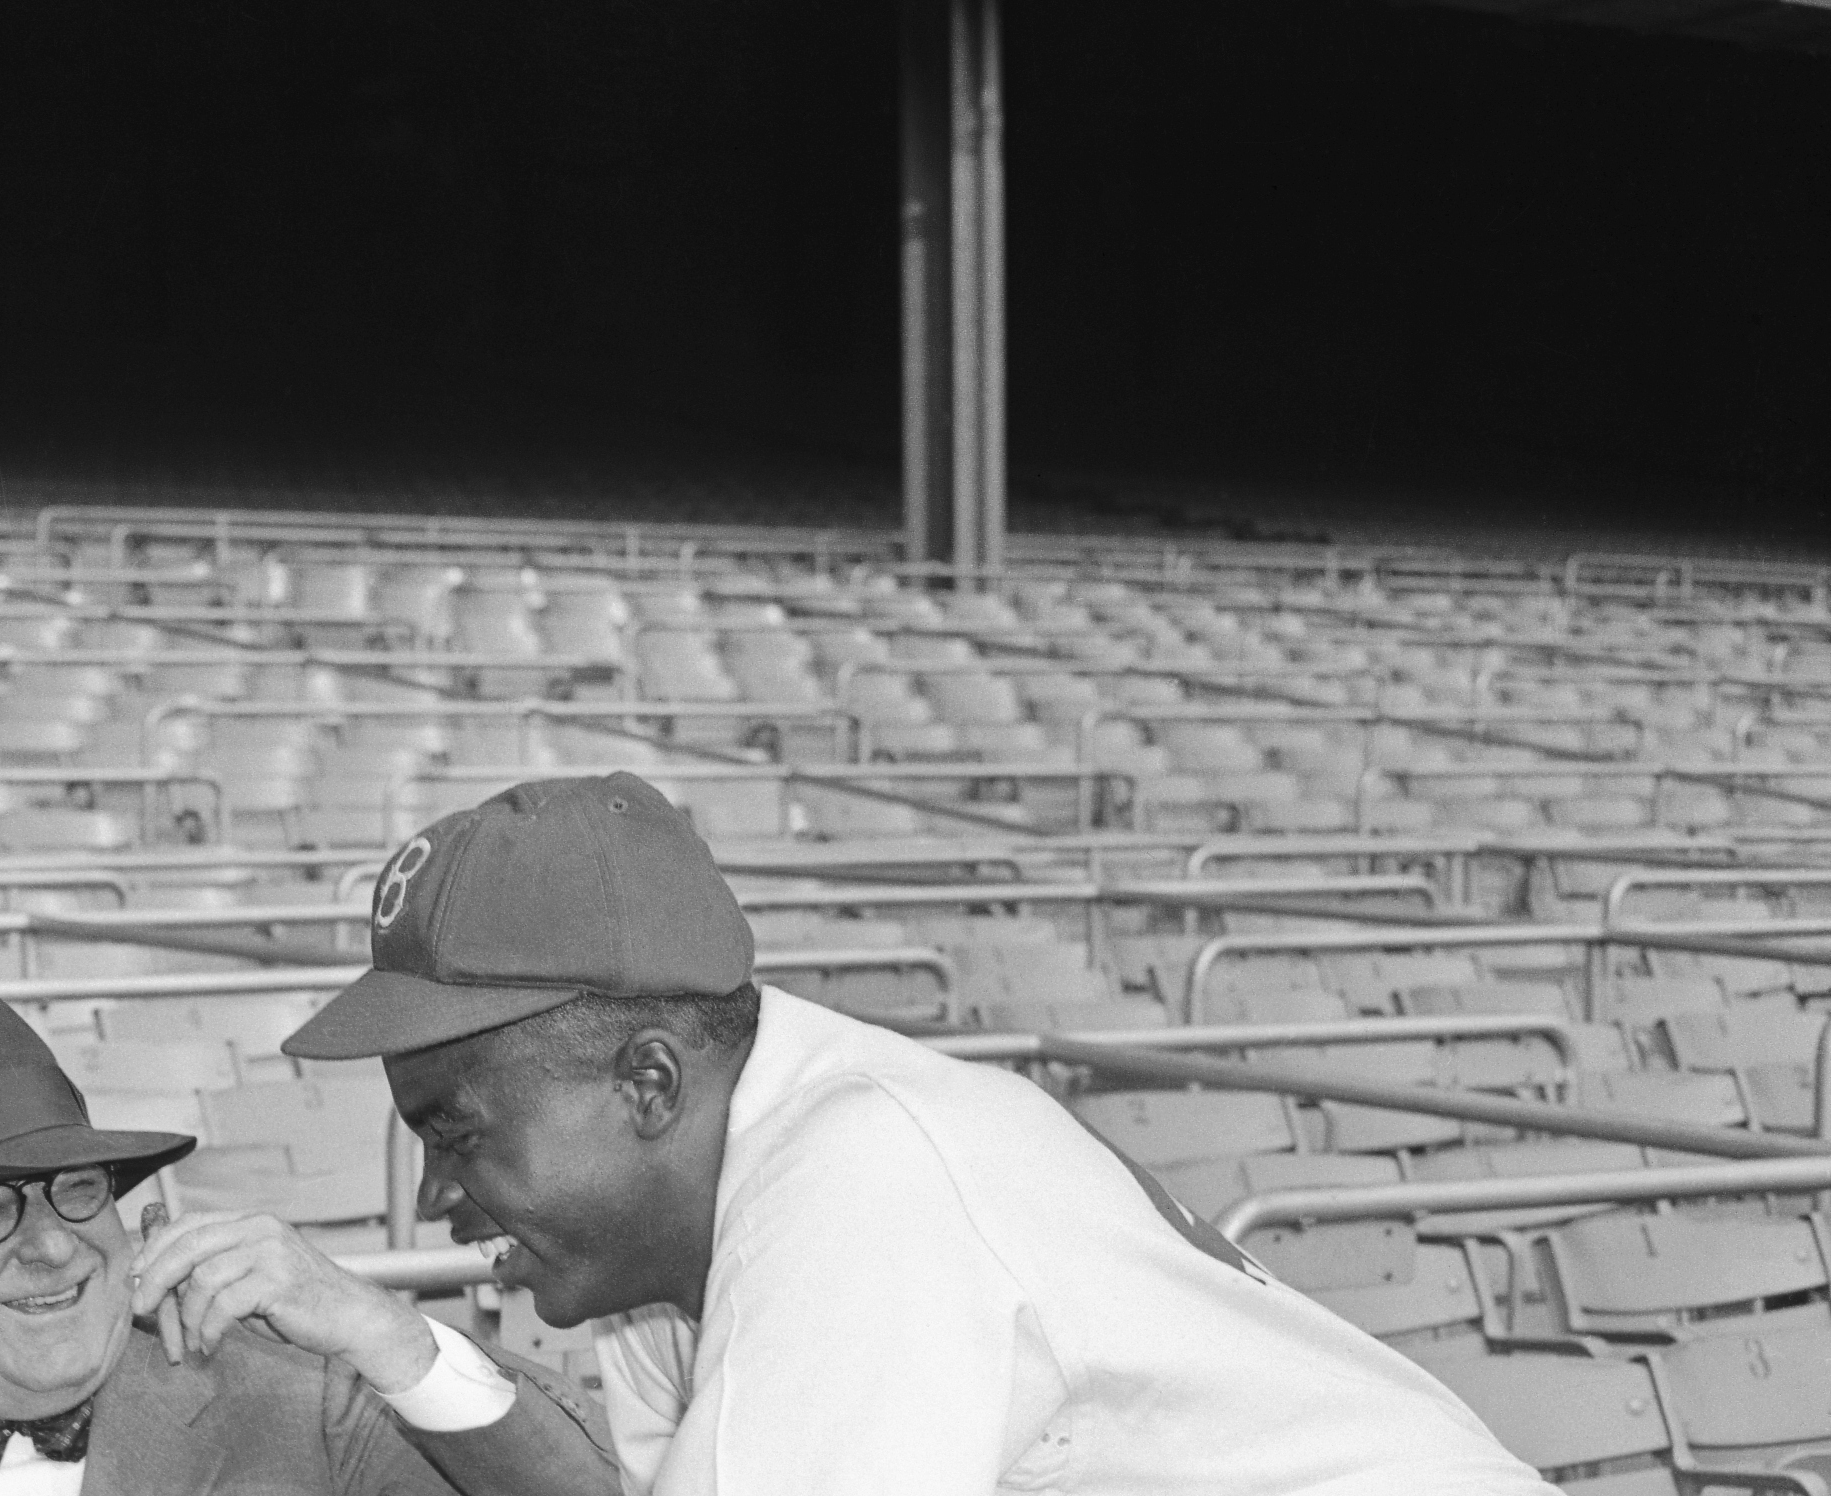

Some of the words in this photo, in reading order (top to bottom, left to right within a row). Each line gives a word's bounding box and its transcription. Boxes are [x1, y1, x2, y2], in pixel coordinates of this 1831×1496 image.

[377, 837, 431, 928] B
[1640, 1224, 1658, 1257] 1
[1745, 1338, 1772, 1379] 3
